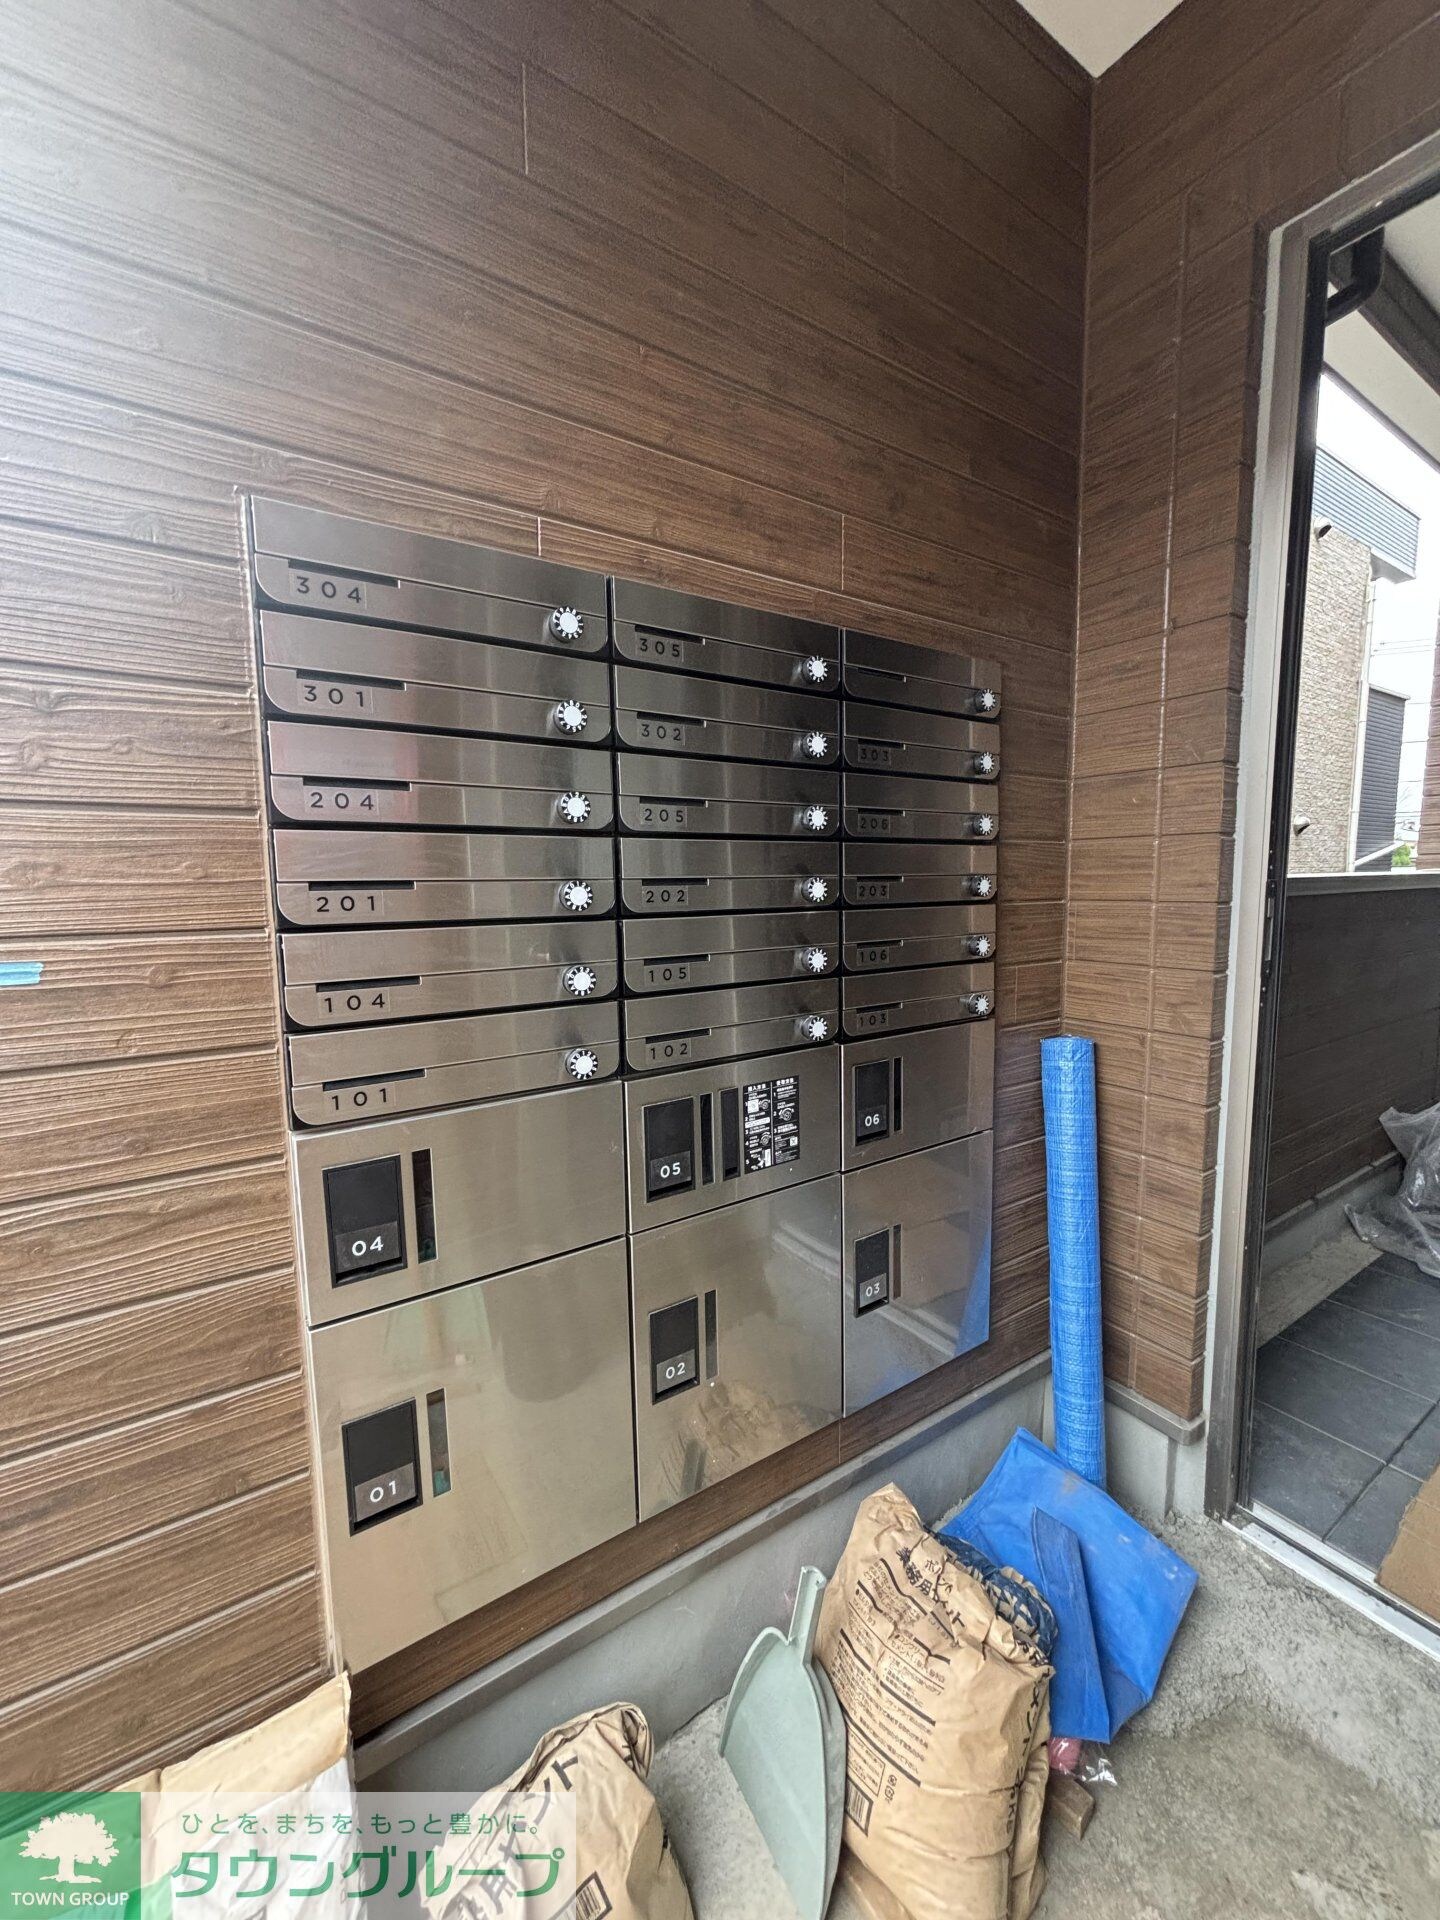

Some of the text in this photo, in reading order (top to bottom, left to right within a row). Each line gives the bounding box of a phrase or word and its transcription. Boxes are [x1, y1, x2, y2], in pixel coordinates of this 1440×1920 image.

[296, 576, 362, 604] 304
[639, 638, 680, 658] 305
[304, 685, 365, 708] 301
[641, 723, 682, 741] 302
[860, 749, 889, 762] 303
[310, 791, 375, 811] 204
[644, 808, 684, 823] 205
[860, 818, 888, 830] 206
[646, 889, 685, 903] 202
[859, 885, 887, 897] 203
[316, 895, 376, 912] 201
[859, 950, 887, 961] 106
[649, 967, 687, 982] 105
[325, 992, 386, 1013] 104
[858, 1013, 886, 1027] 103
[650, 1043, 688, 1060] 102
[331, 1087, 388, 1111] 101
[864, 1113, 880, 1128] 06
[660, 1161, 682, 1179] 05
[351, 1235, 384, 1256] 04
[865, 1283, 880, 1298] 03
[665, 1361, 686, 1380] 02
[369, 1479, 398, 1503] 01
